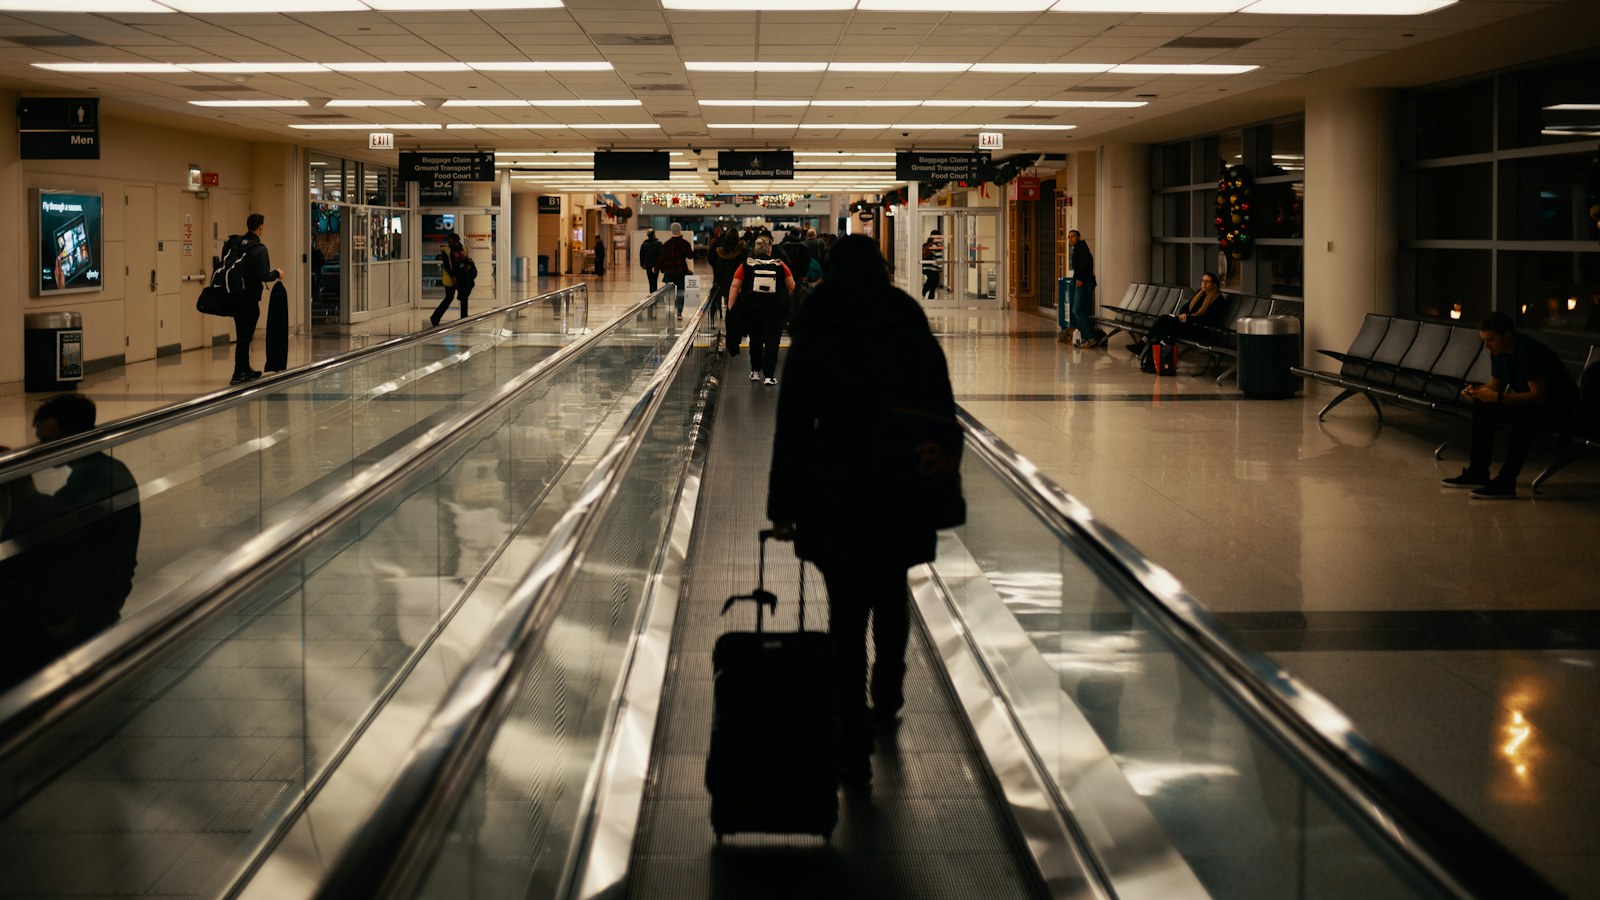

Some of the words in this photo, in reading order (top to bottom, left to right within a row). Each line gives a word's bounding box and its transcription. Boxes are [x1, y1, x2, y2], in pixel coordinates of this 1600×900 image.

[70, 136, 94, 144] Men
[372, 135, 390, 146] EXIT
[982, 134, 1000, 146] EXIT
[720, 169, 743, 177] Moving
[548, 197, 560, 205] B1
[49, 202, 65, 212] through
